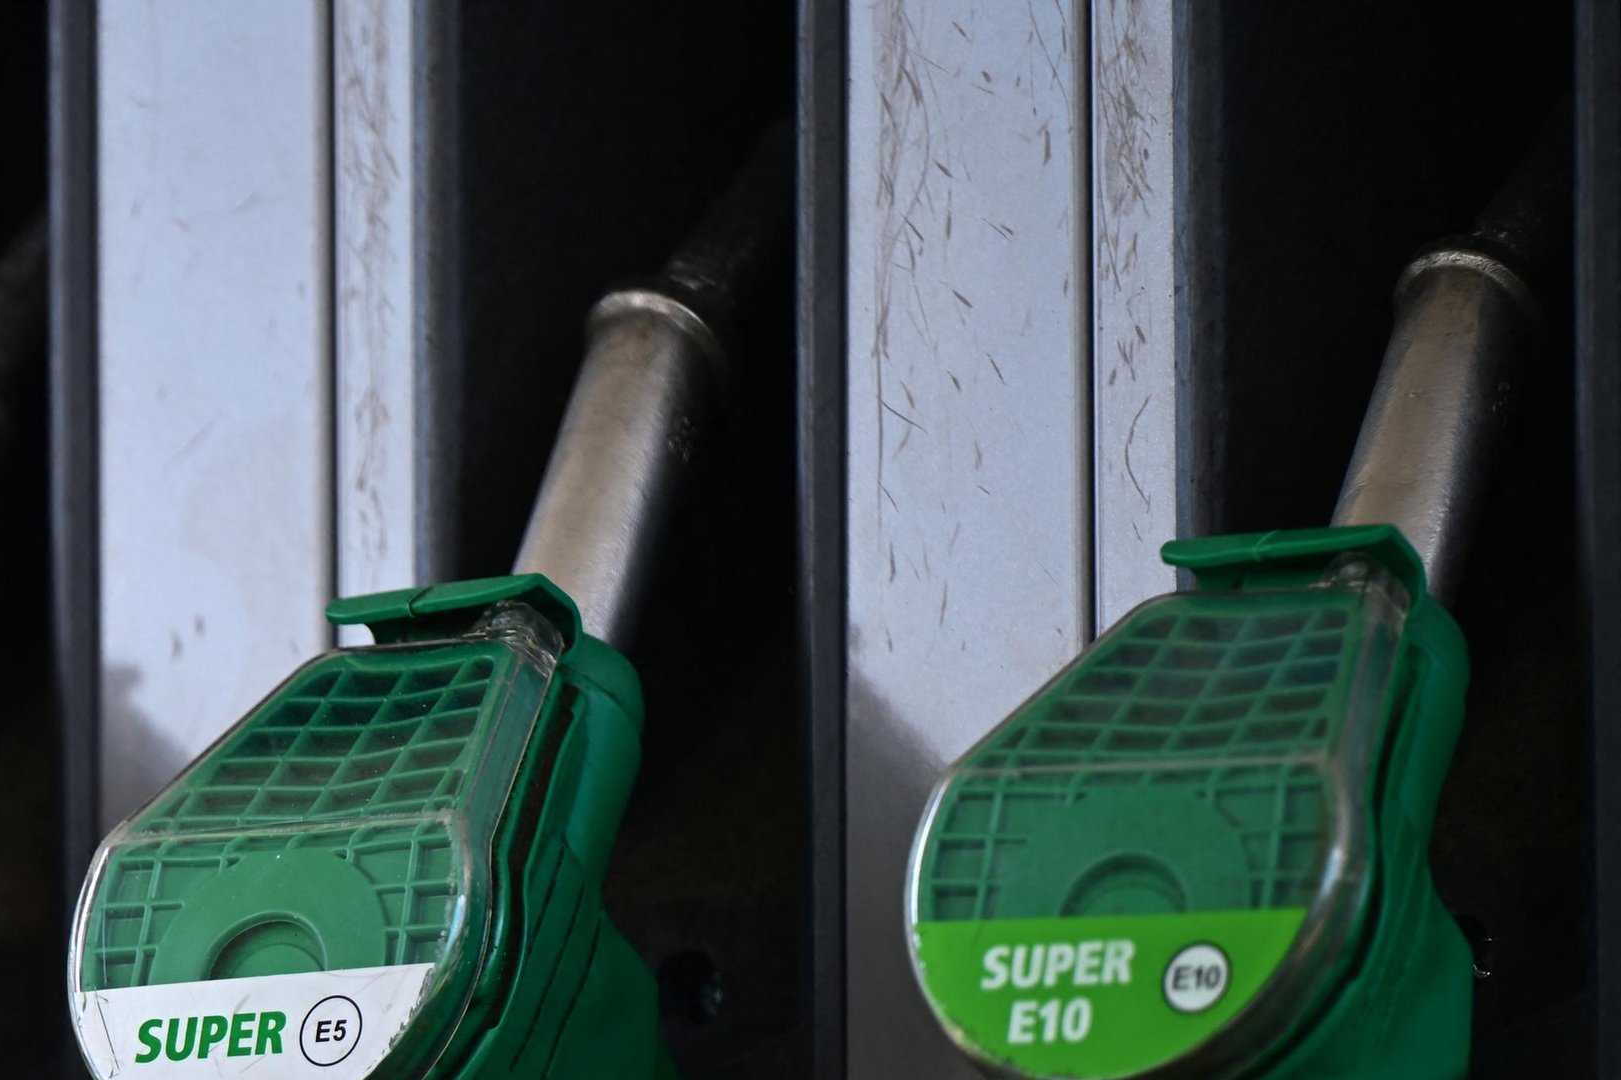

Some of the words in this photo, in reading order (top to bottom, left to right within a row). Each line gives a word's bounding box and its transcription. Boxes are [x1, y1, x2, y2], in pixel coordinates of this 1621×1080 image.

[980, 939, 1136, 990] SUPER
[1172, 965, 1221, 992] E10
[135, 1010, 287, 1064] SUPER
[315, 1019, 347, 1043] E5
[1007, 998, 1093, 1045] E10
